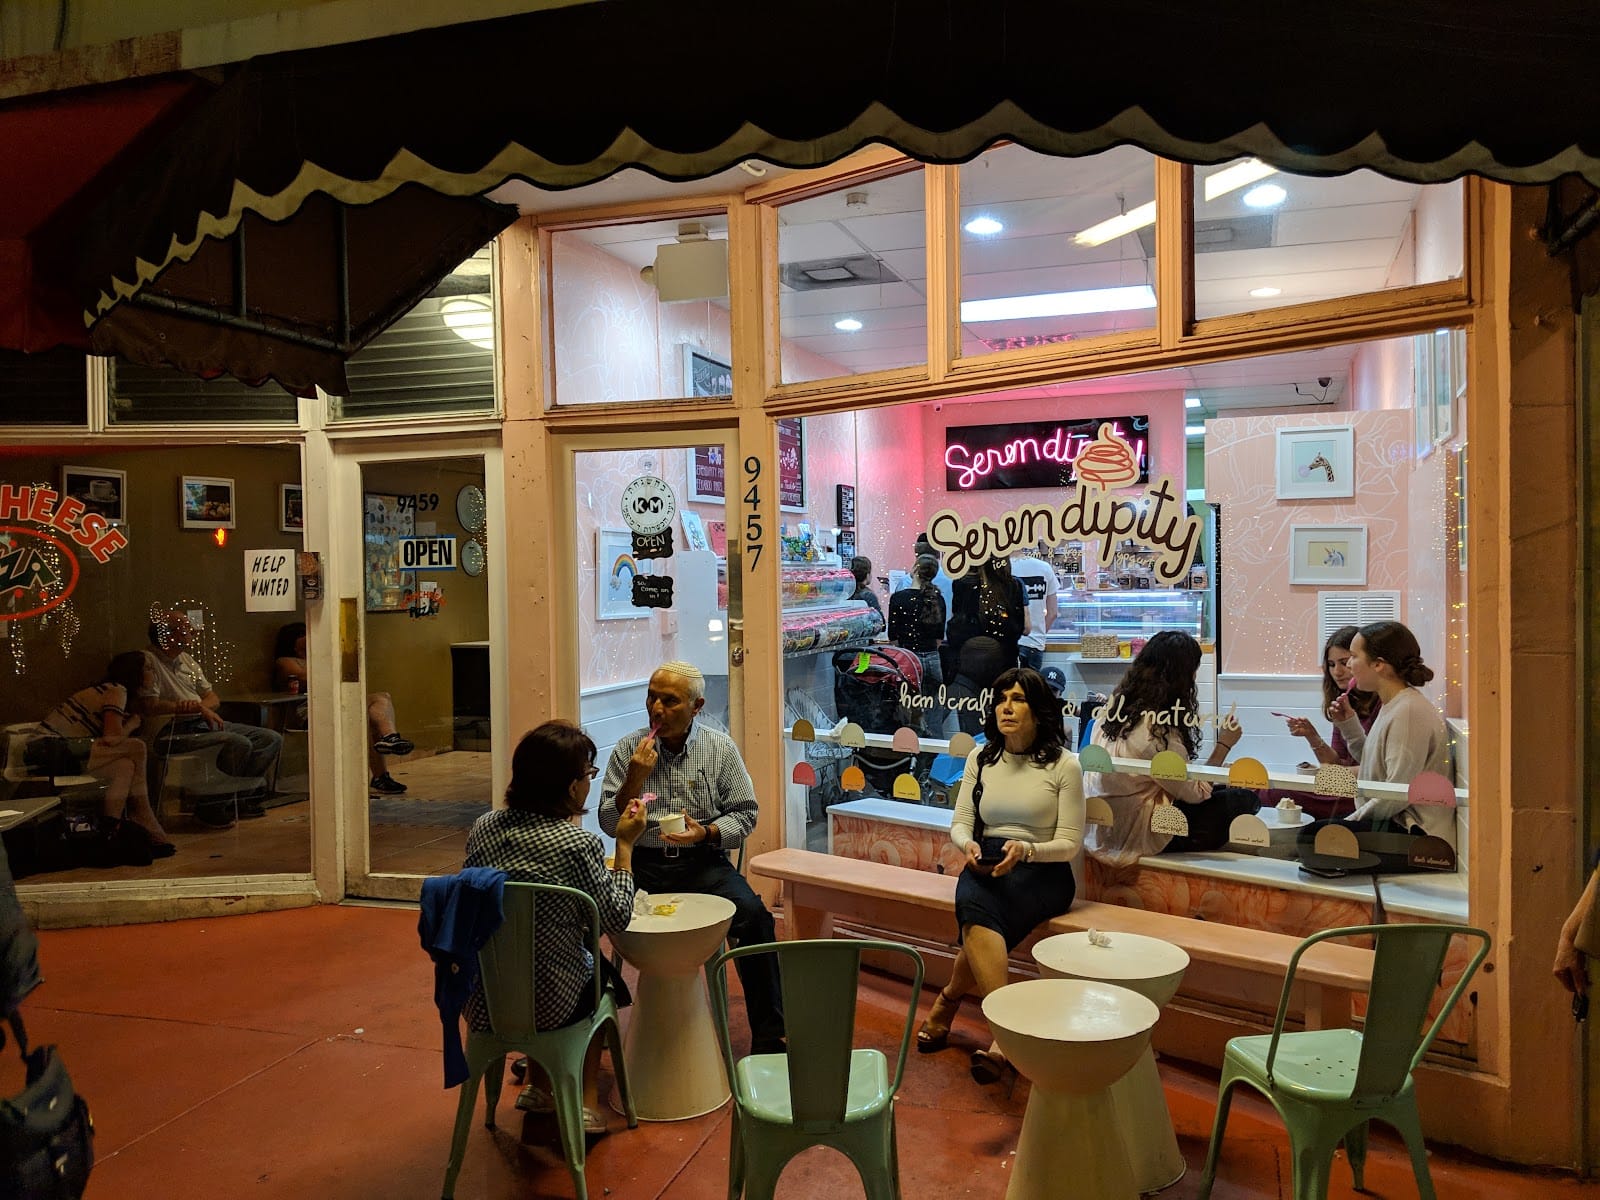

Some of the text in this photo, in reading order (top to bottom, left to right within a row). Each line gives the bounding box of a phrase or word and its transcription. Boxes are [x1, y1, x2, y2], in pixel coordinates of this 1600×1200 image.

[397, 493, 439, 513] 9459
[743, 456, 763, 572] 9457
[931, 479, 1197, 579] Serendipity
[636, 534, 665, 547] OPEN
[403, 540, 453, 567] OPEN
[251, 555, 286, 574] HELP
[992, 559, 1008, 570] ice
[250, 577, 289, 598] WANTED
[1091, 694, 1128, 724] all
[1140, 698, 1240, 732] natural
